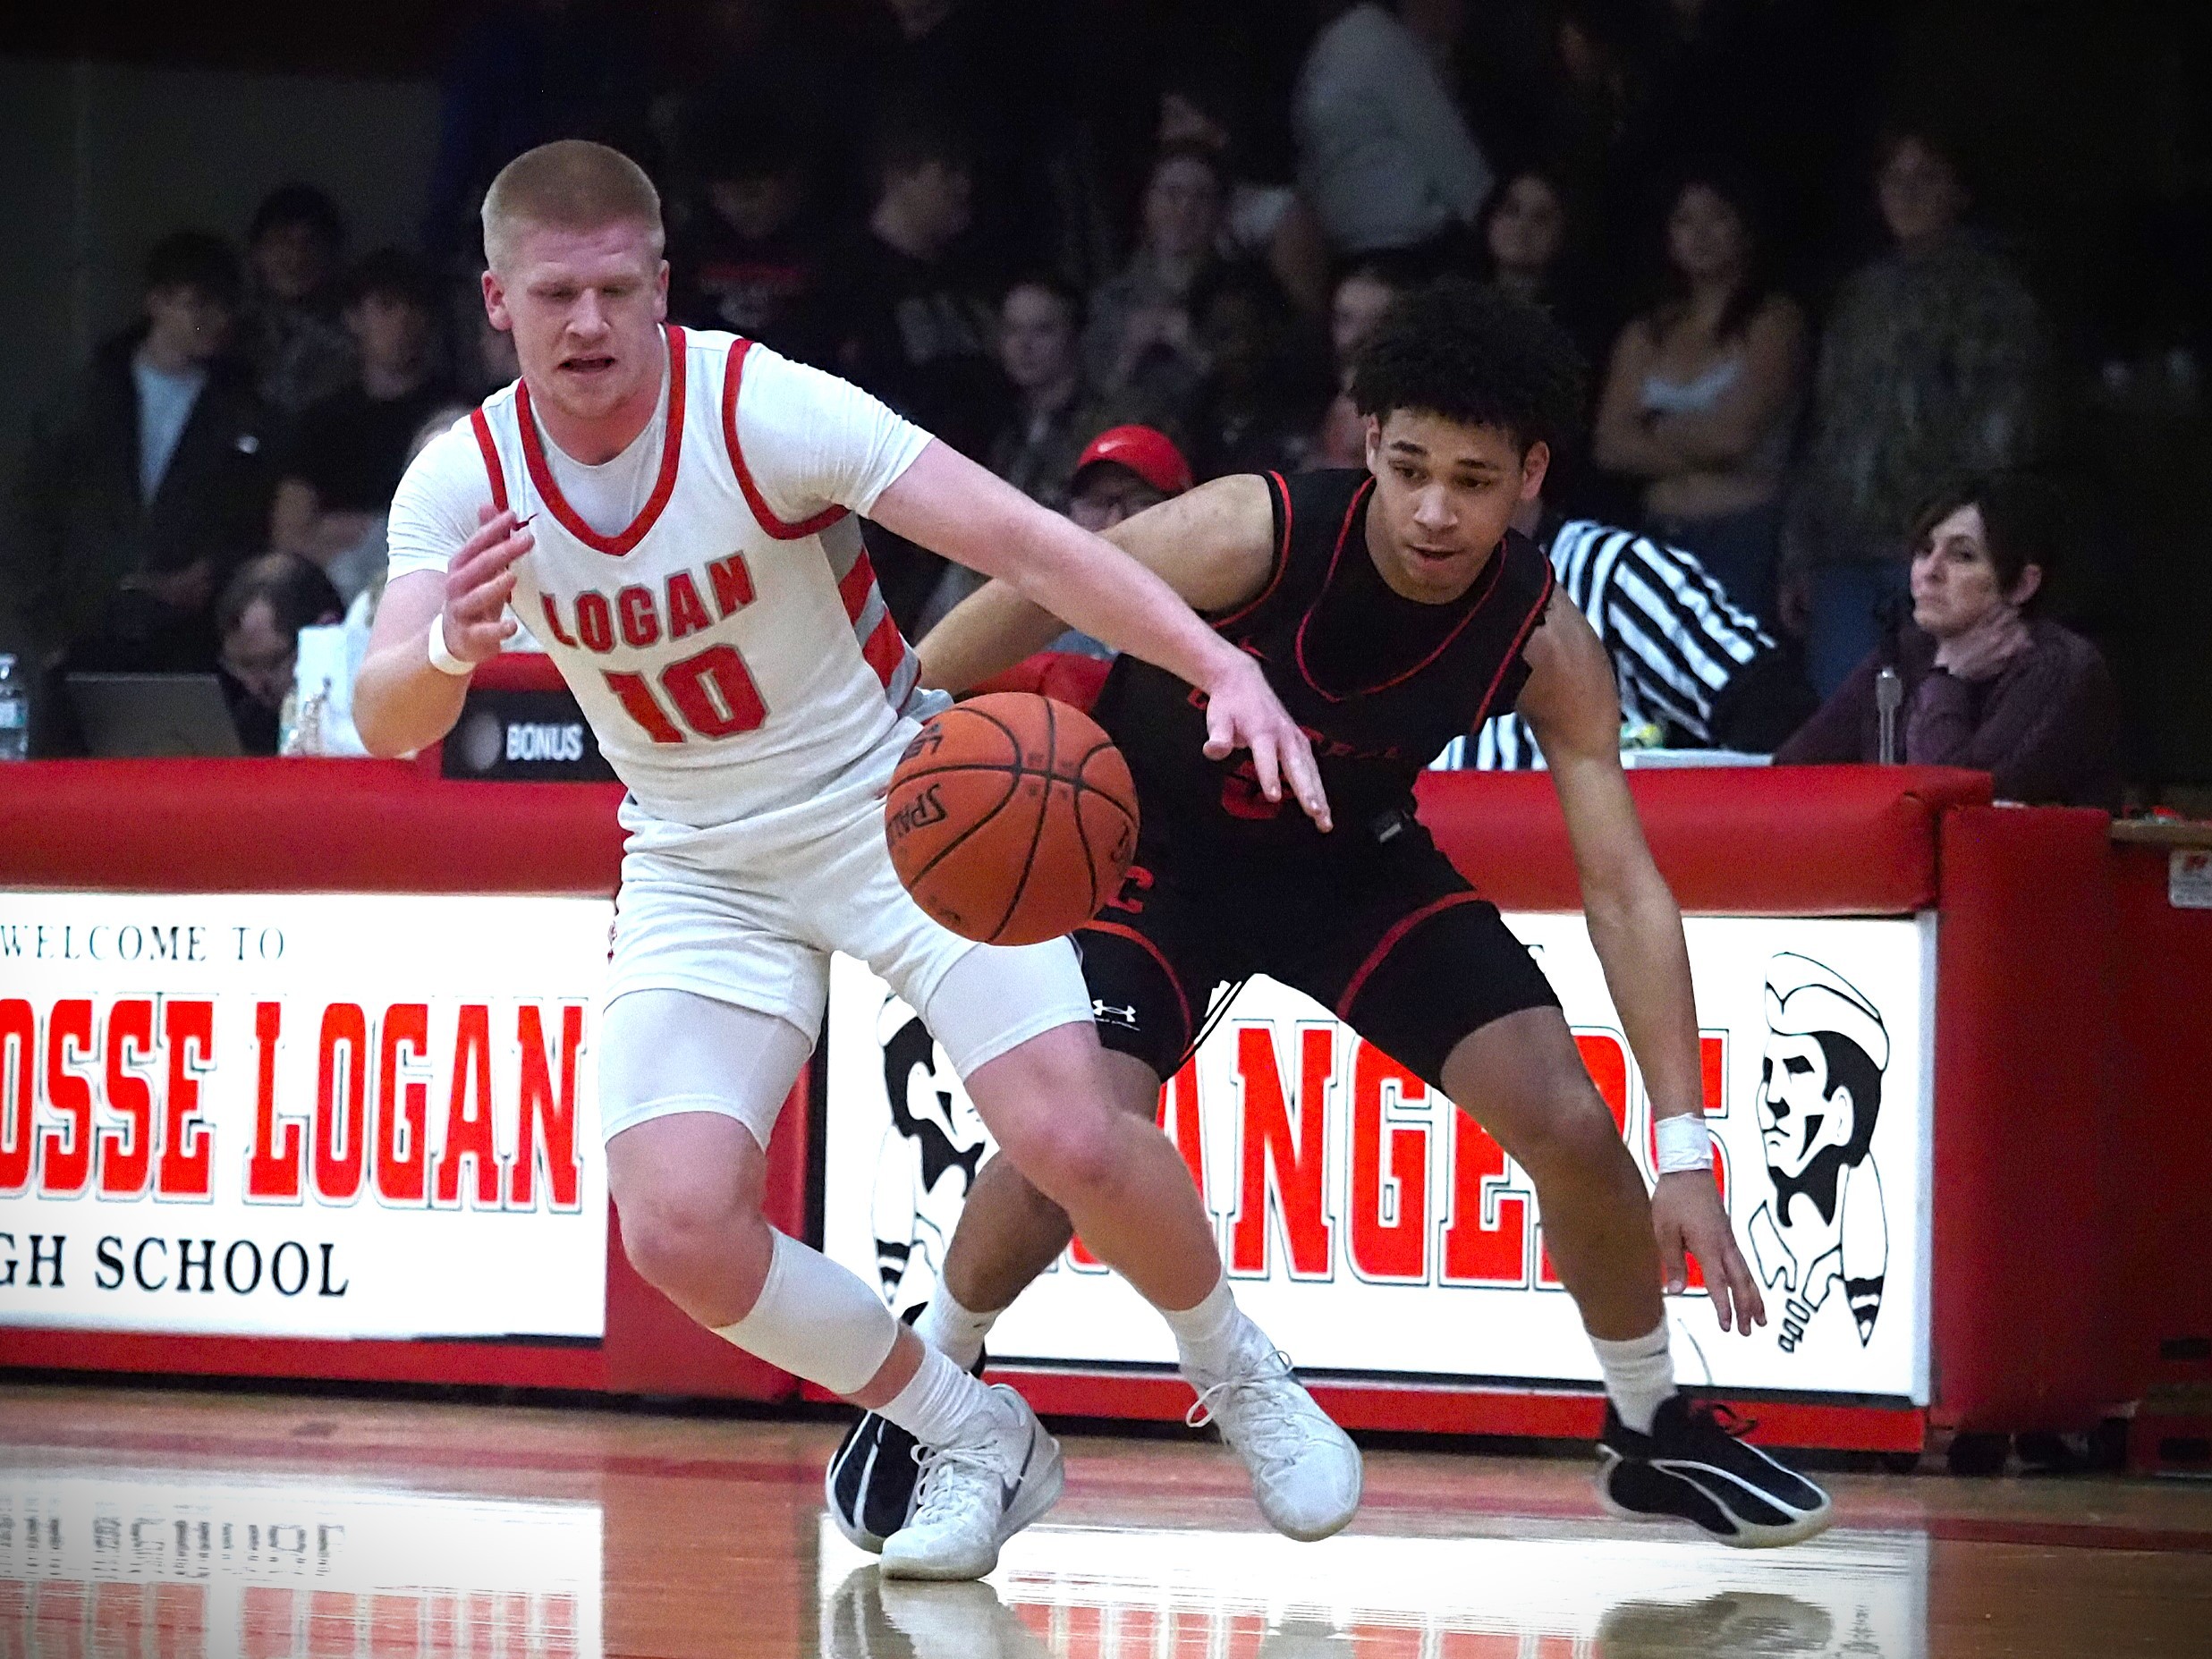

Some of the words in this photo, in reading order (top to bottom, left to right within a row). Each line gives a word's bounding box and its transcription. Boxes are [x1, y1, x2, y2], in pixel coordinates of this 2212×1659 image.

[539, 550, 757, 654] LOGAN
[598, 643, 770, 743] 10
[505, 722, 583, 761] BONUS
[0, 924, 207, 961] WELCOME
[233, 927, 285, 961] TO
[242, 995, 588, 1214] LOGAN
[95, 1235, 349, 1297] SCHOOL
